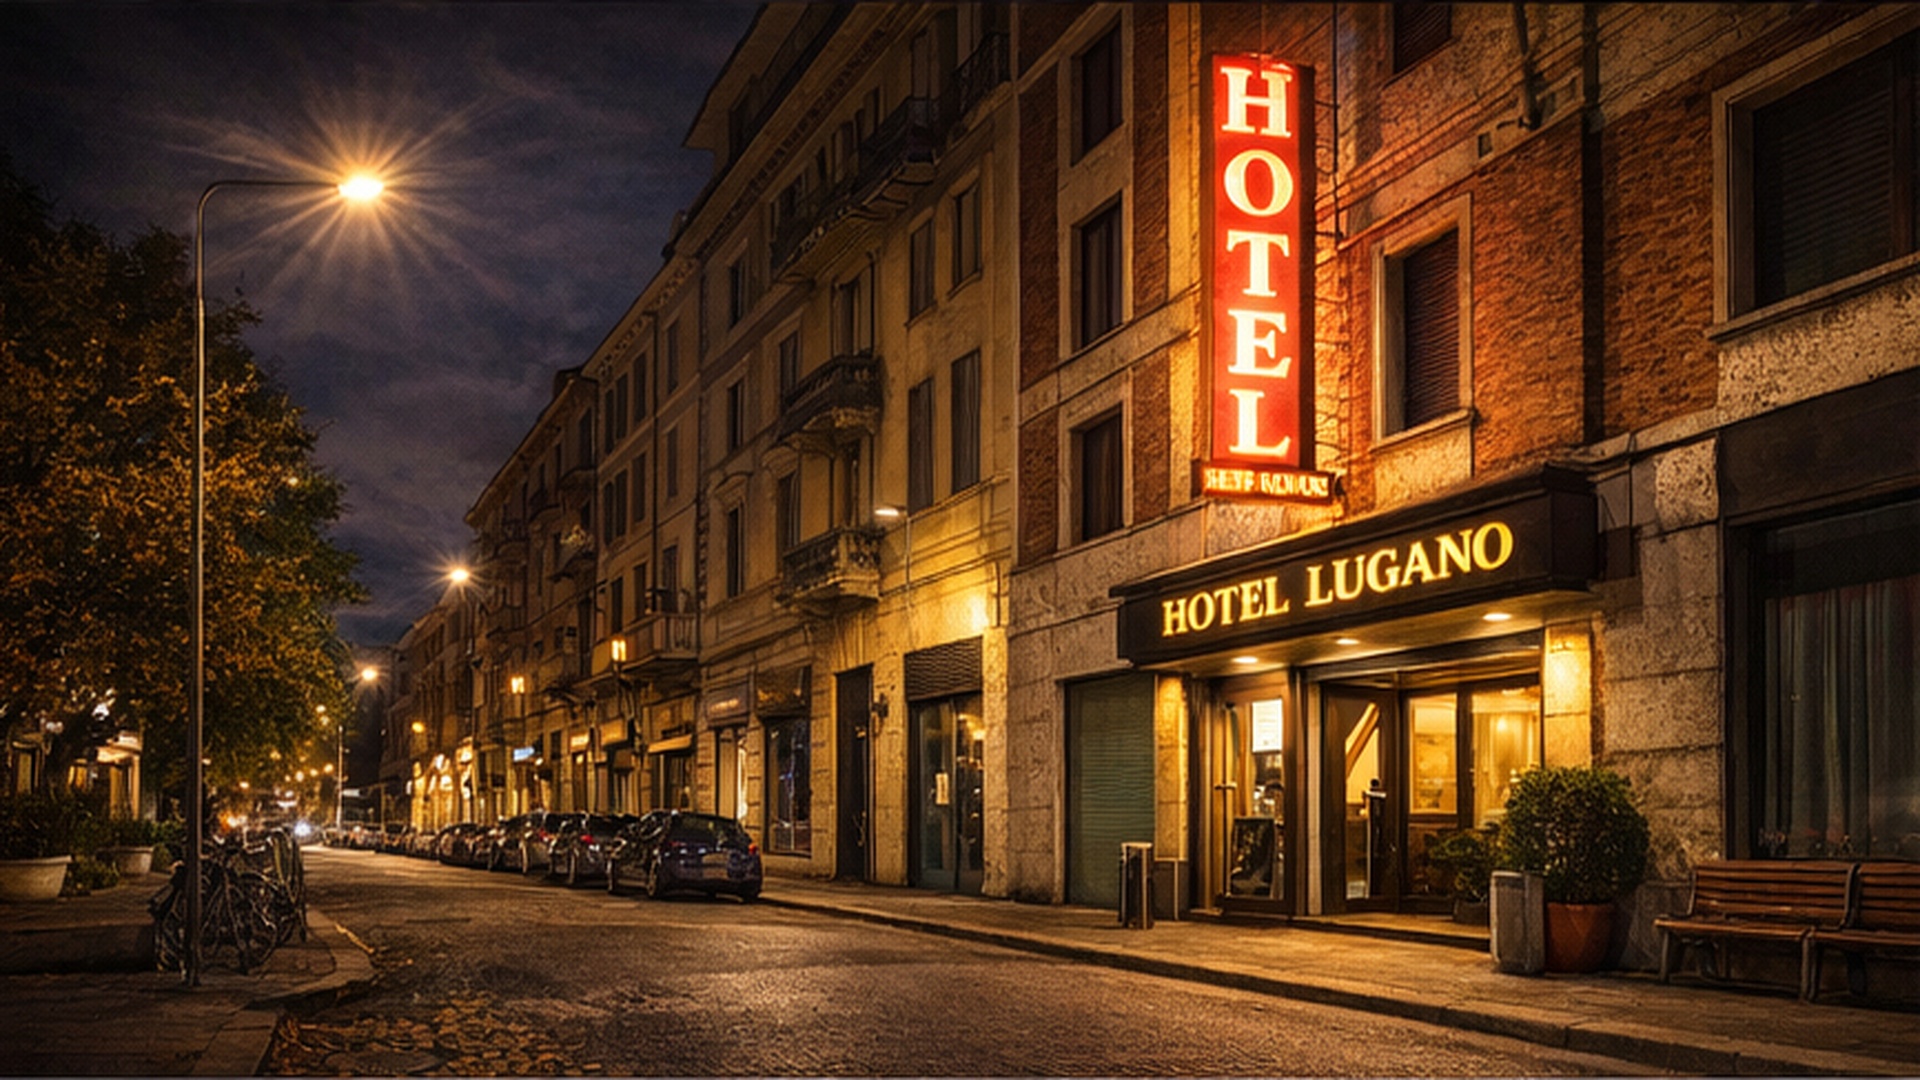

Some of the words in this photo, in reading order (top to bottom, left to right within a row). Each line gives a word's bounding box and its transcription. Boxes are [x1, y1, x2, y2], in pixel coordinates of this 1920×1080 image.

[1220, 66, 1293, 456] HOTEL
[1162, 577, 1289, 637] HOTEL
[1305, 522, 1513, 607] LUGANO
